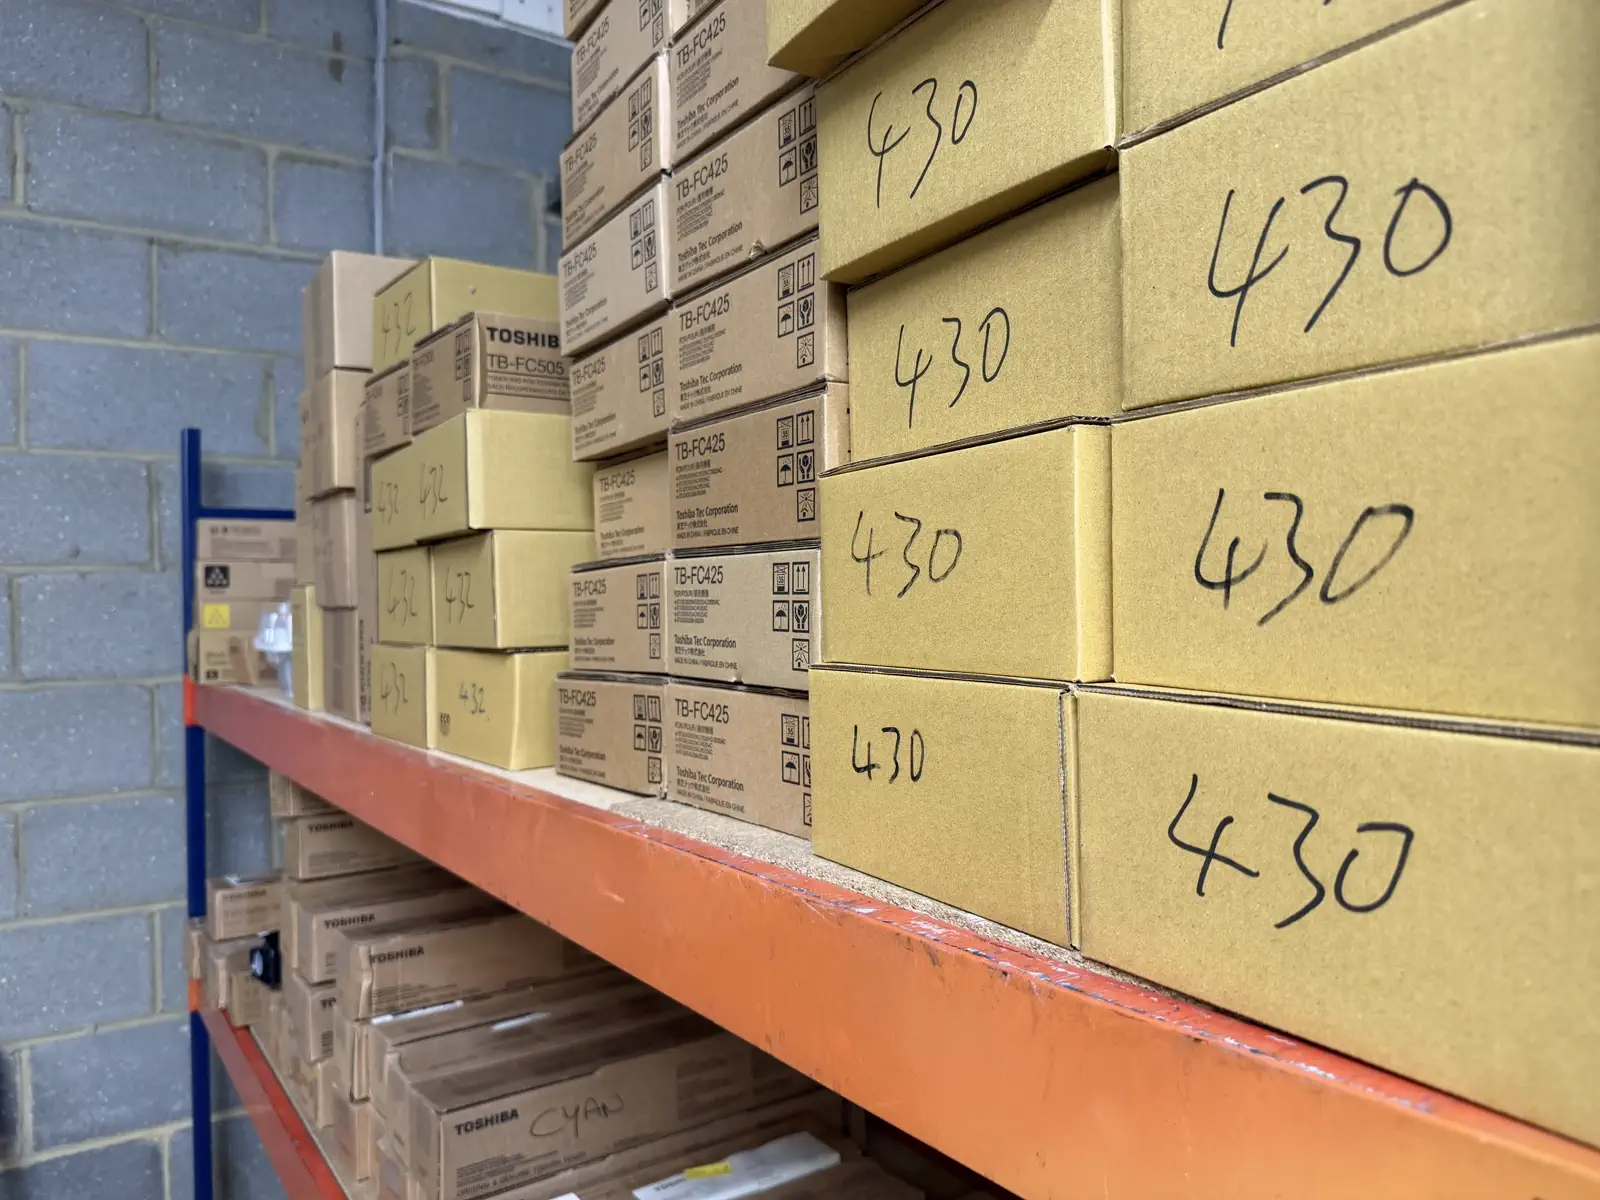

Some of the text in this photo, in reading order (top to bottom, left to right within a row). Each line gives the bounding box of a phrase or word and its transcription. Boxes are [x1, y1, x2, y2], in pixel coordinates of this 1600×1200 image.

[677, 12, 726, 68] TB-FC425
[867, 77, 977, 209] 430
[676, 152, 728, 201] TB-FC425
[708, 221, 743, 247] Corporation
[1207, 175, 1453, 348] 430
[679, 293, 730, 331] TB-FC425
[486, 325, 560, 349] TOSHIB
[486, 353, 565, 376] TB-FC505
[700, 374, 708, 385] Tec
[709, 363, 742, 381] Corporation
[894, 307, 1011, 429] 430
[675, 433, 726, 461] TB-FC425
[599, 469, 636, 492] TB-FC425
[696, 507, 704, 518] Tec
[705, 503, 739, 518] Corporation
[851, 510, 963, 599] 430
[1194, 487, 1415, 628] 430
[573, 578, 607, 597] TB-FC425
[674, 565, 724, 585] TB-FC425
[693, 635, 702, 646] Tec
[703, 636, 737, 649] Corporation
[459, 682, 486, 715] 432
[558, 688, 597, 707] TB-FC425
[675, 697, 729, 724] TB-FC425
[852, 724, 925, 784] 430
[676, 765, 744, 792] Toshiba Tec Corporation
[308, 820, 354, 833] TOSHIBA
[1167, 773, 1415, 929] 430
[324, 913, 376, 930] TOSHIBA
[369, 945, 425, 964] TOSHIBA
[454, 1108, 520, 1136] TOSHIBA
[529, 1094, 625, 1139] CYAN
